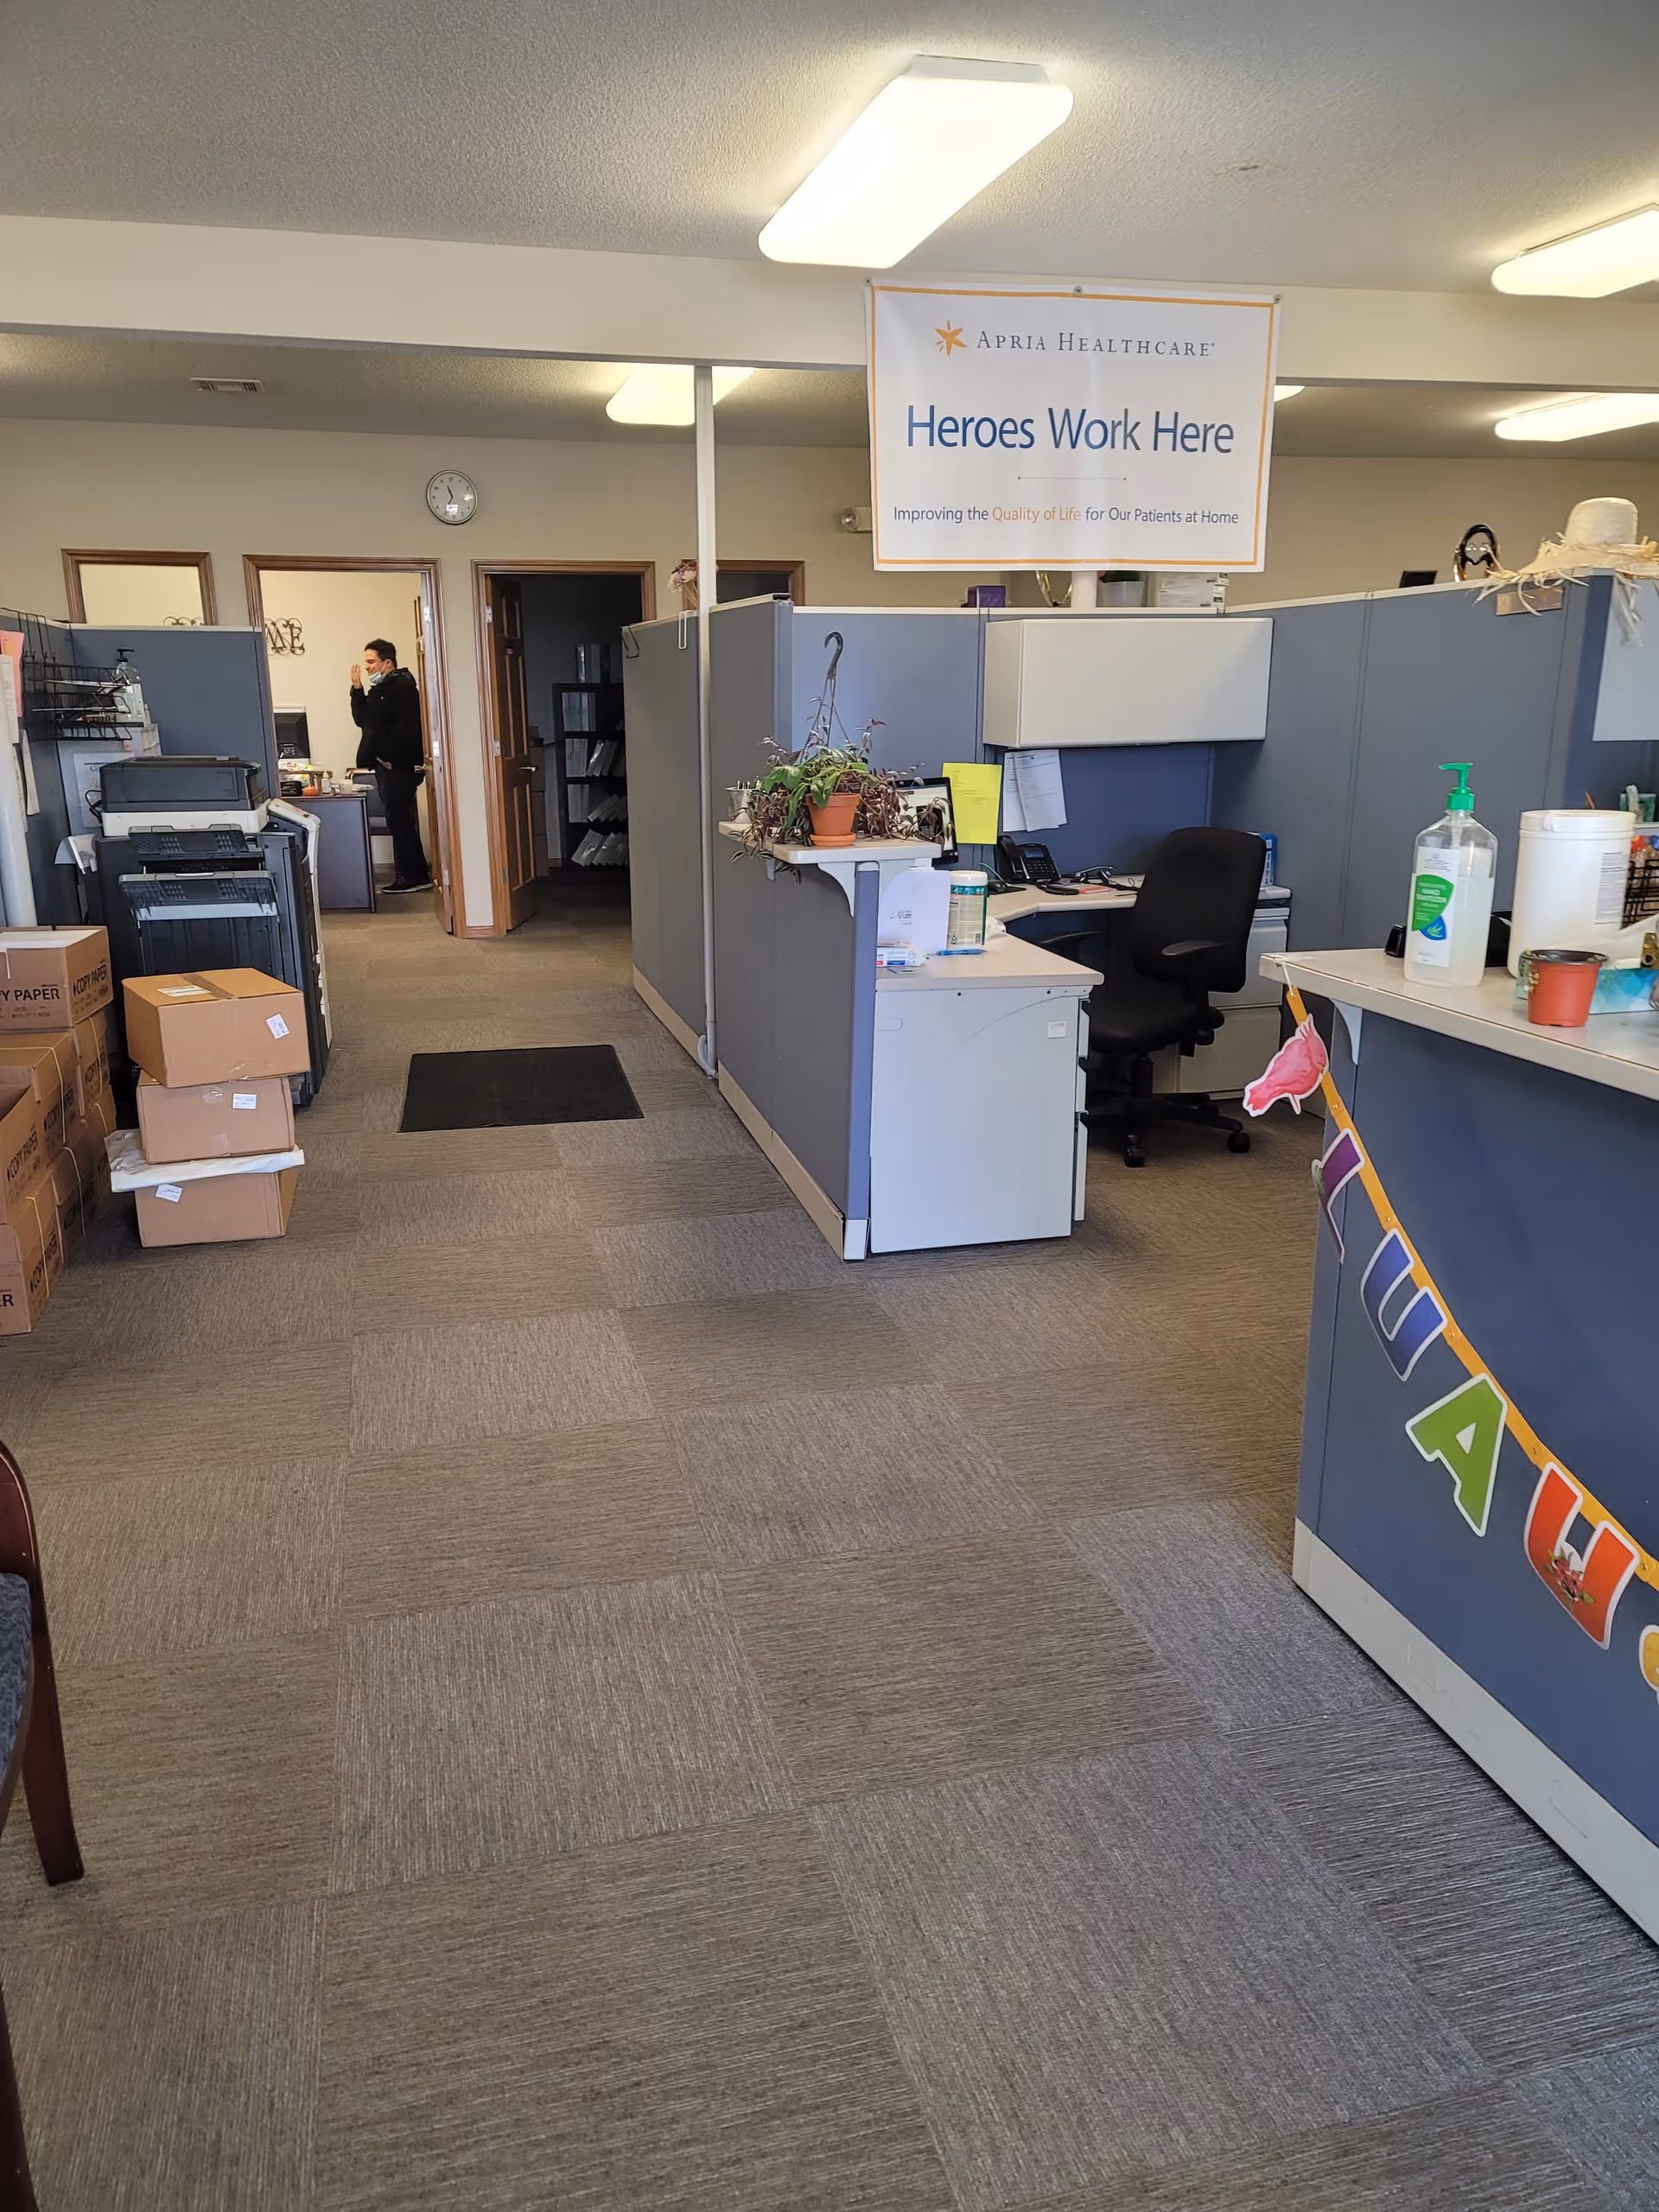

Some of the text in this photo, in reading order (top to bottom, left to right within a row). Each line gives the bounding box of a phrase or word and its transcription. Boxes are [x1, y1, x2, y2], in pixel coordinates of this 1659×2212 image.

[976, 330, 1046, 351] APRIA
[906, 404, 1235, 454] Heroes Work Here
[894, 506, 1239, 524] Improving the Quality of Life for Our Patients at Home
[76, 963, 107, 995] COPY PAPER
[14, 988, 60, 1001] PAPER
[10, 1131, 39, 1179] COPY PAPER
